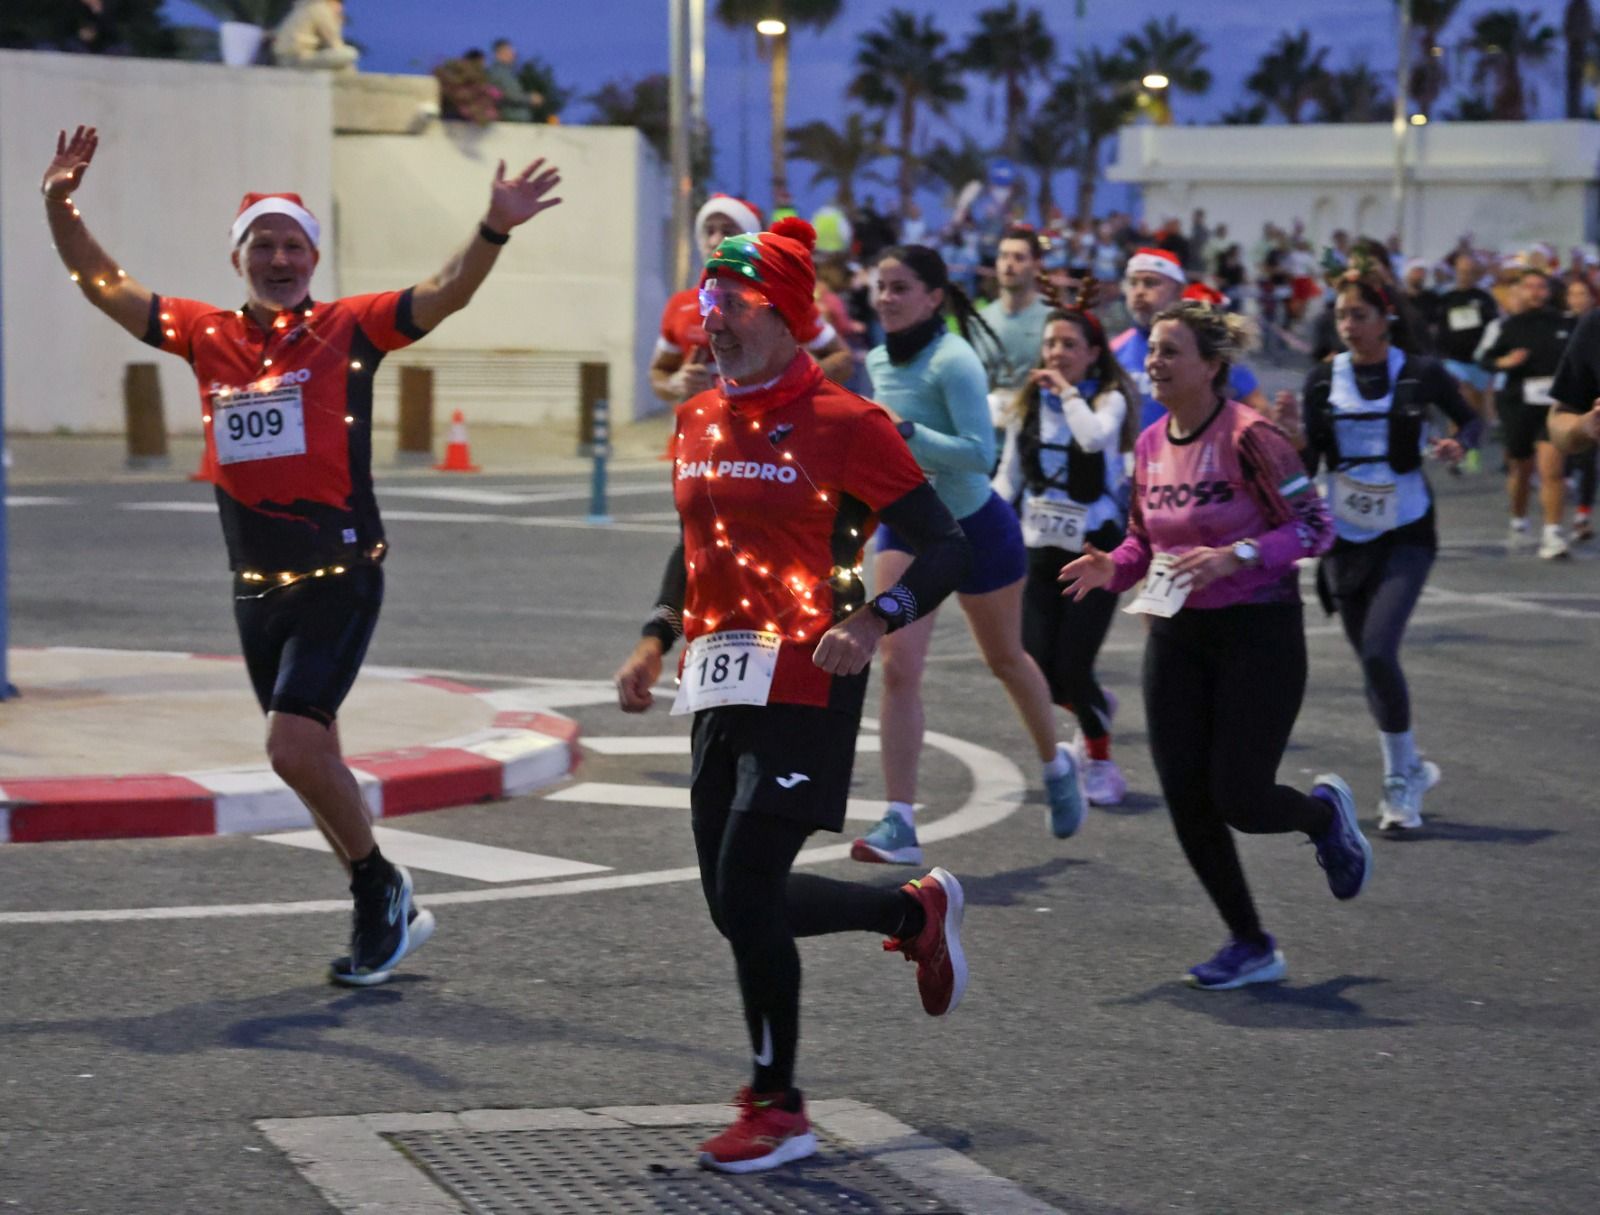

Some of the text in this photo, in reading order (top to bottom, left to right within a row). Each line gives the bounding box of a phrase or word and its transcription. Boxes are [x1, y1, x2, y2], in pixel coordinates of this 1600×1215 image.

[227, 408, 283, 441] 909
[678, 461, 797, 483] SAN PEDRO
[699, 652, 750, 687] 181
